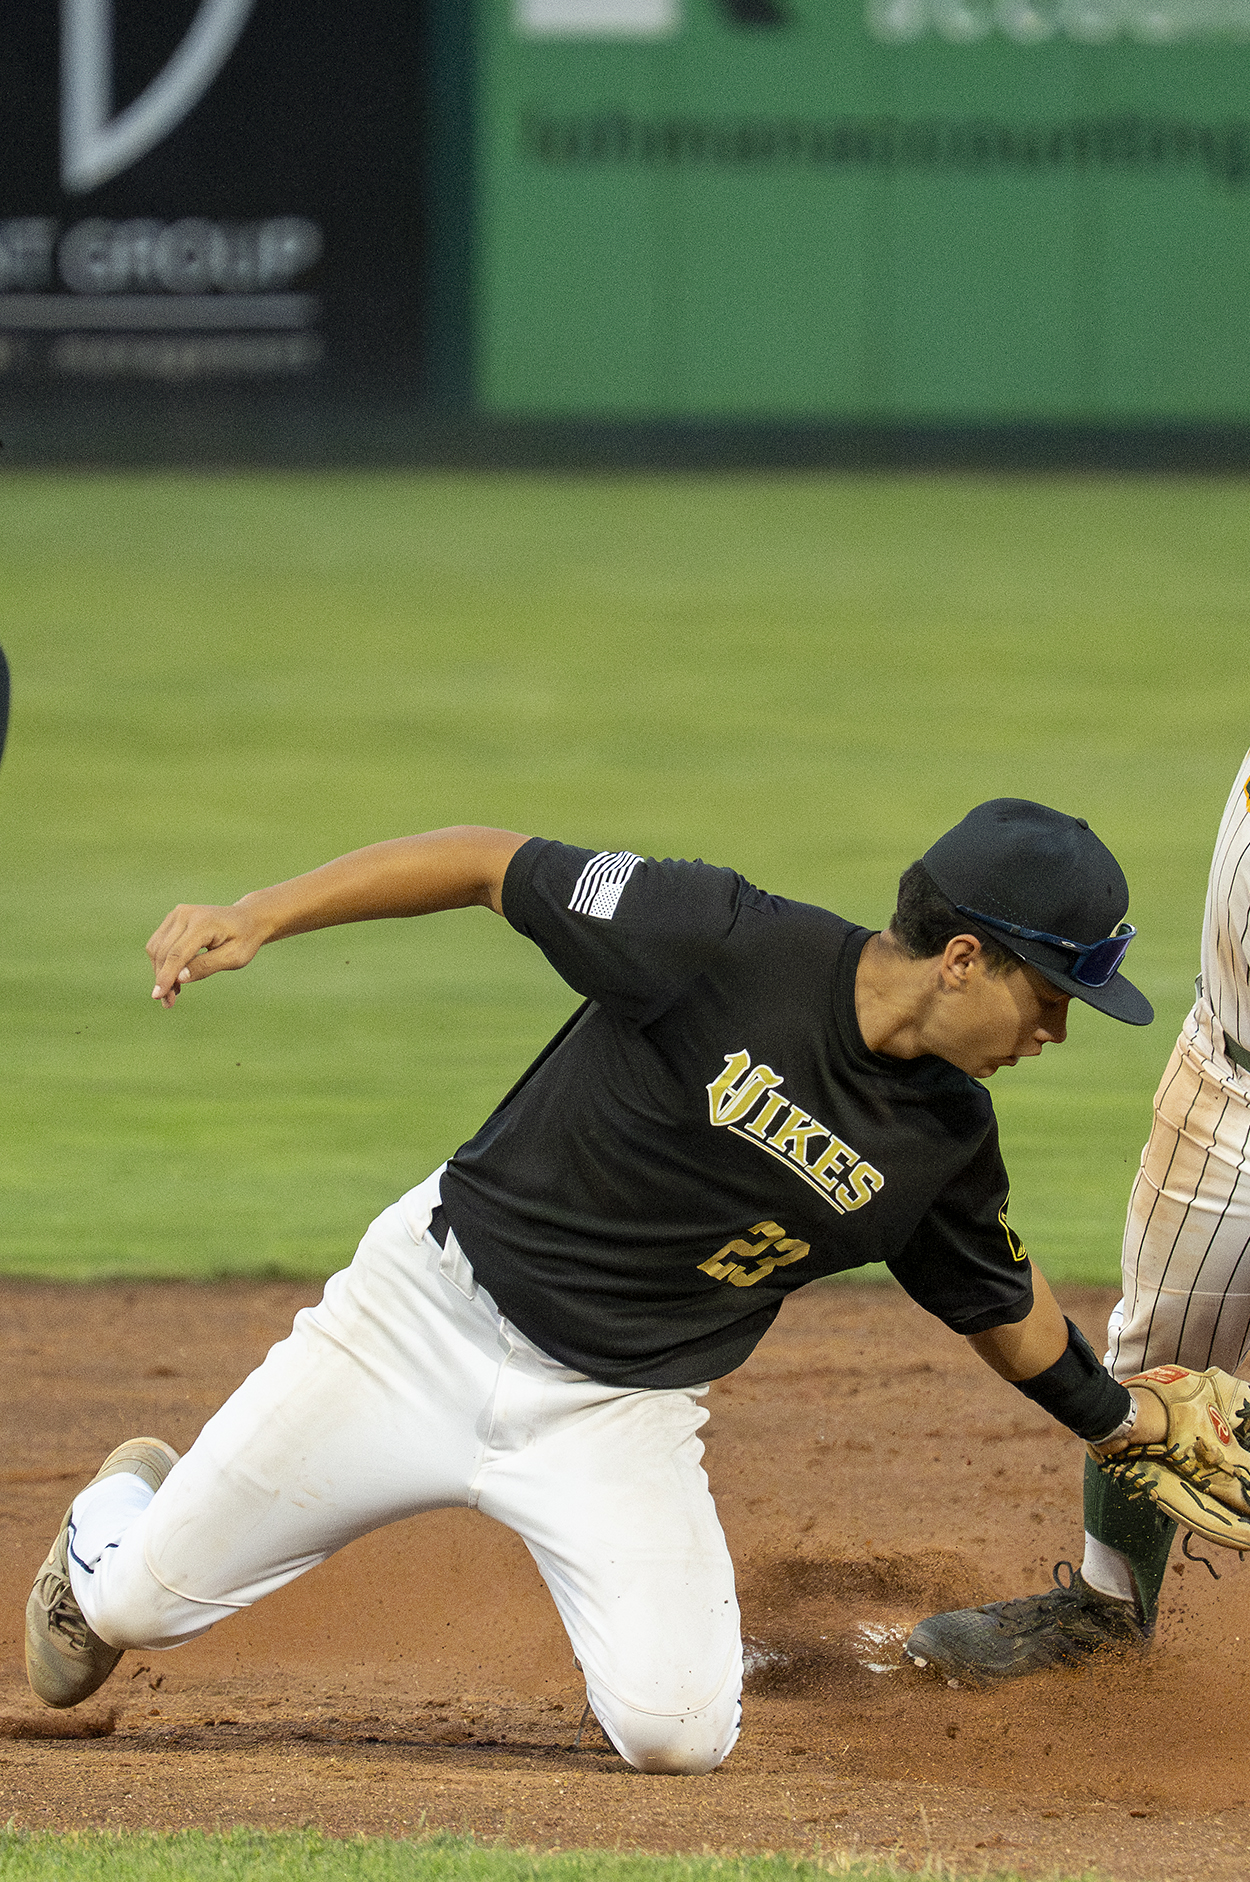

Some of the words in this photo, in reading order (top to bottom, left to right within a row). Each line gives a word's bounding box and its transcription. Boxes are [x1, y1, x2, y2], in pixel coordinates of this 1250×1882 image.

[60, 217, 321, 291] GROUP
[706, 1048, 884, 1212] VIKES
[697, 1220, 811, 1287] 23
